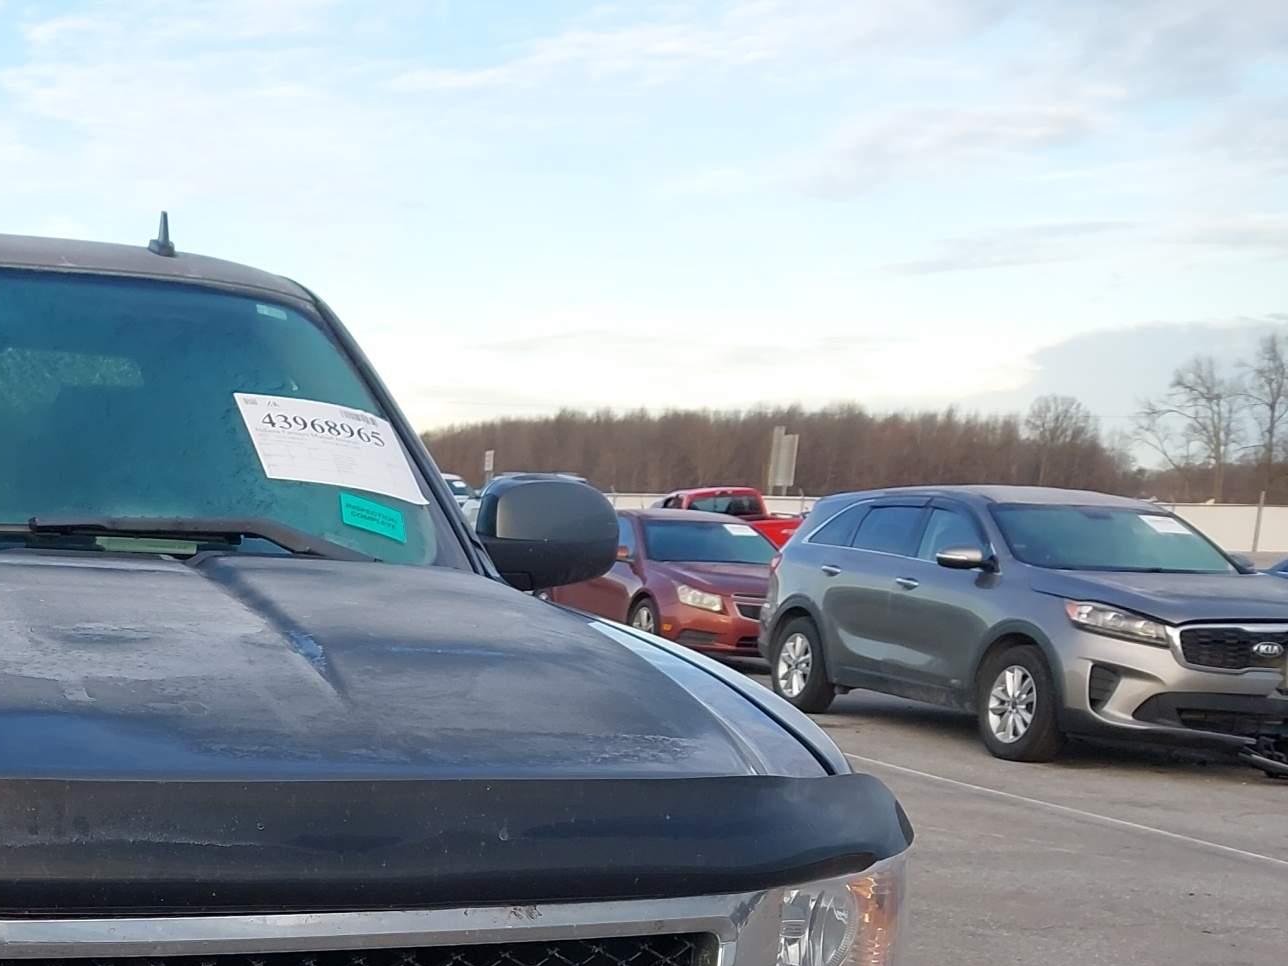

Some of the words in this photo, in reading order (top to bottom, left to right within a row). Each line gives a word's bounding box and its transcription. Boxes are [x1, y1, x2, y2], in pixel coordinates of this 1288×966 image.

[262, 412, 385, 447] 43968965
[350, 511, 396, 530] COMPLETE
[1259, 644, 1280, 655] KIA
